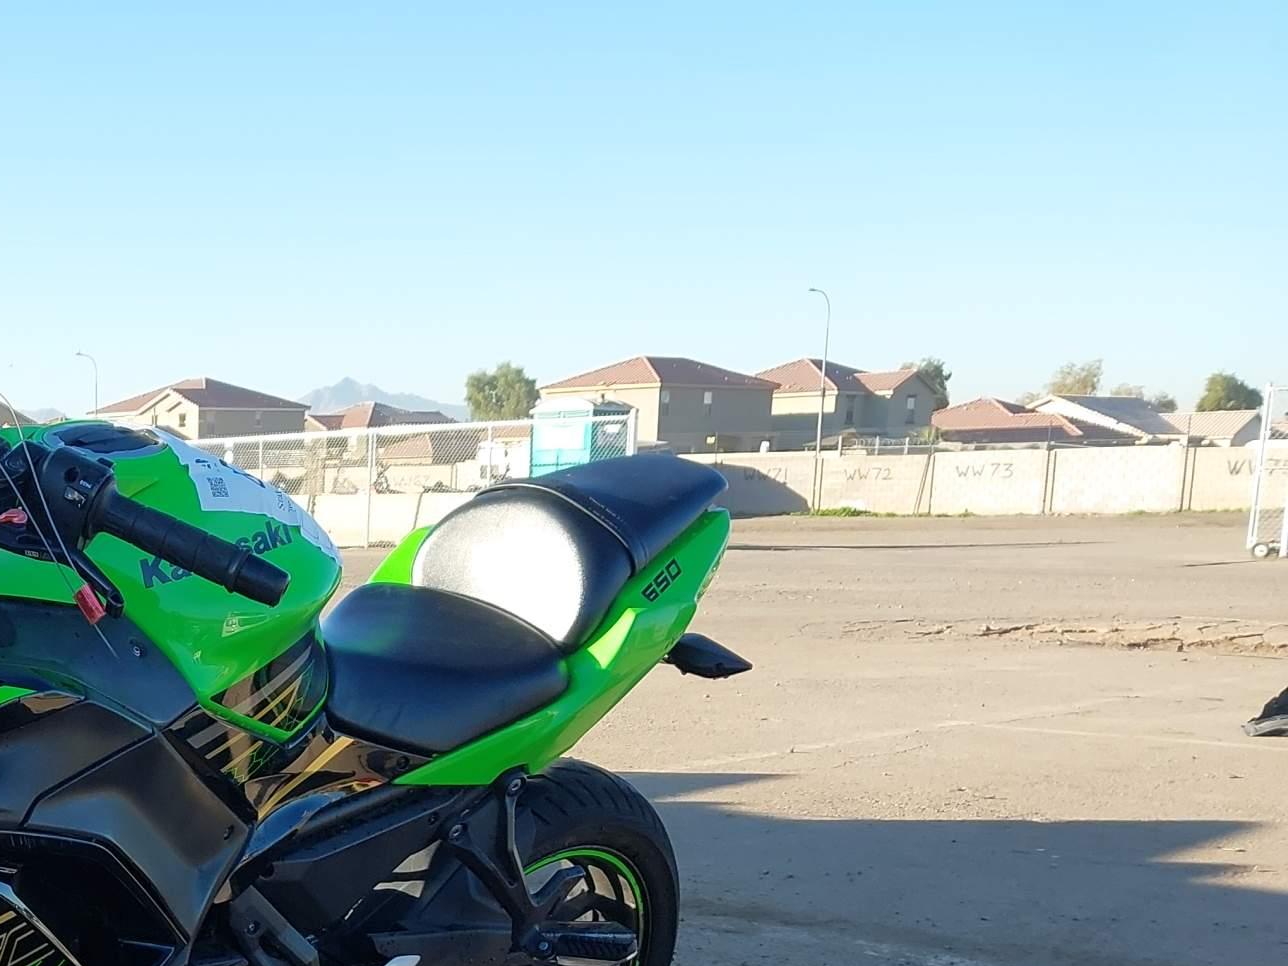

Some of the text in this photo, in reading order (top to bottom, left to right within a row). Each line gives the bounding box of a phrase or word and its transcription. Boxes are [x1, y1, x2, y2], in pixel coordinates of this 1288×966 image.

[743, 466, 789, 482] WW71
[843, 466, 894, 482] WW72
[641, 558, 682, 602] 650
